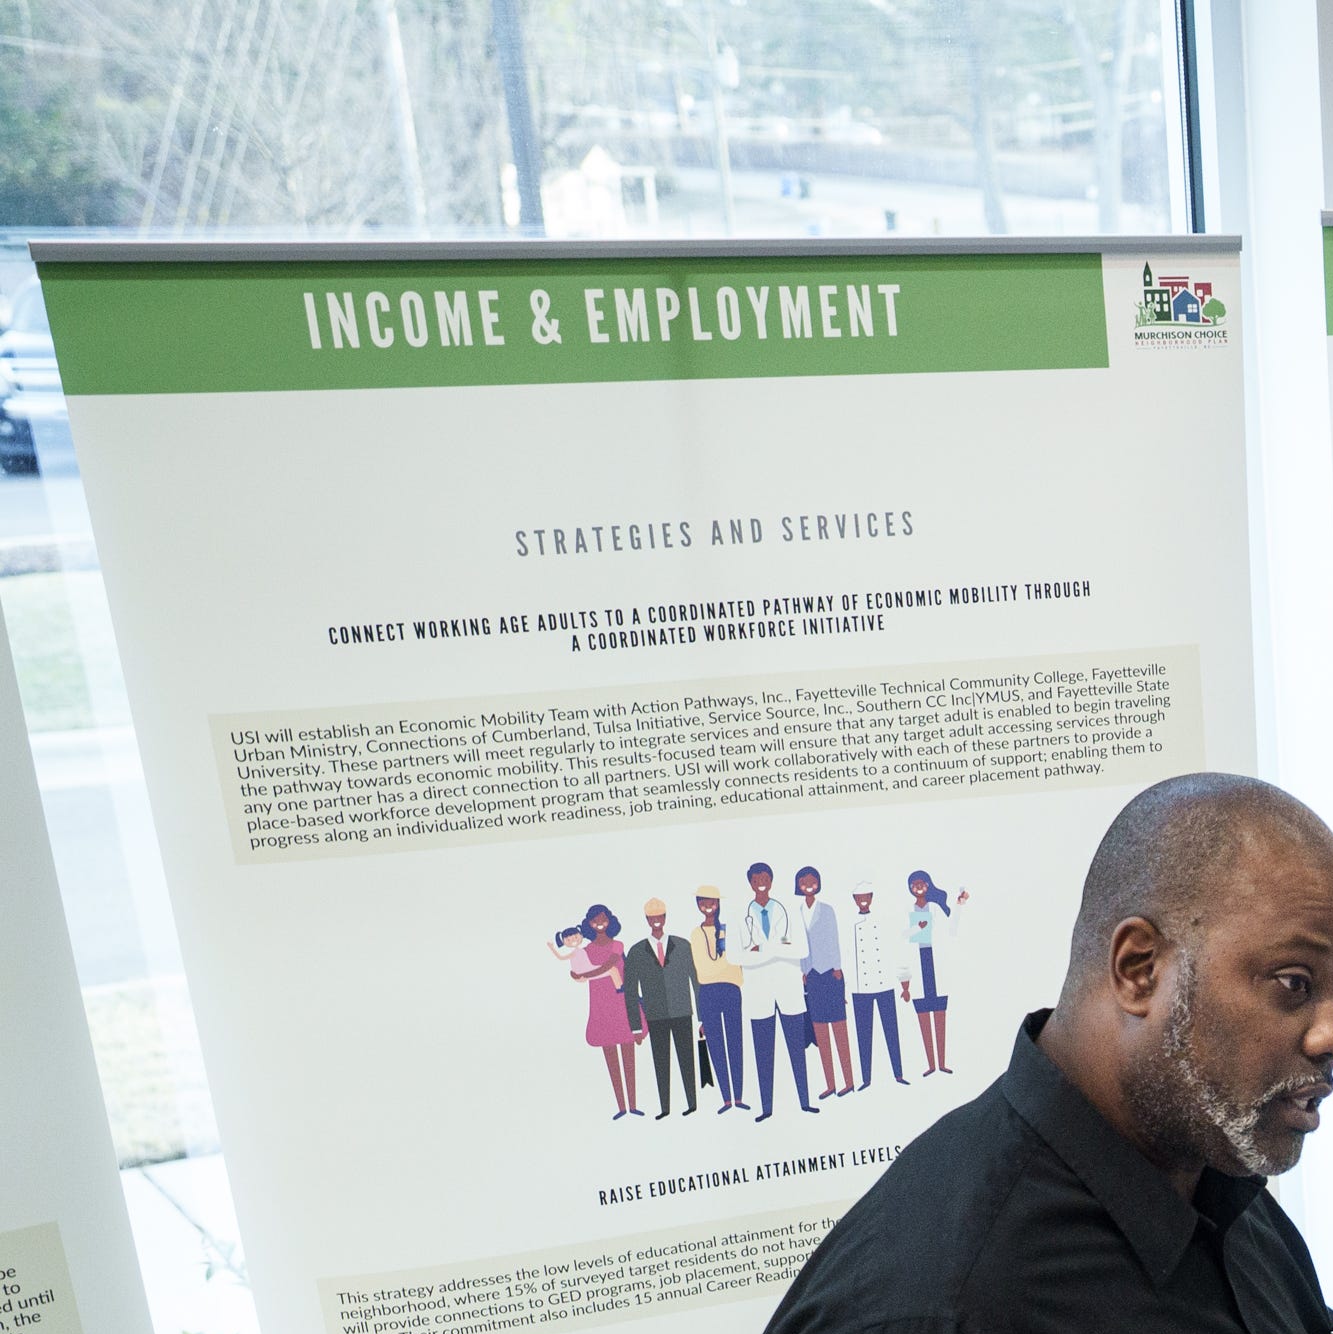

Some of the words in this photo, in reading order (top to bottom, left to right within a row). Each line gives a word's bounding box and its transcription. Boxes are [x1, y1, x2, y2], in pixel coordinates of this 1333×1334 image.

[303, 289, 505, 349] INCOME
[529, 288, 562, 345] &
[583, 283, 900, 343] EMPLOYMENT
[1134, 331, 1192, 340] MURCHISON
[1193, 330, 1227, 339] CHOICE
[515, 521, 692, 557] STRATEGIES
[711, 518, 762, 546] AND
[781, 510, 913, 542] SERVICES
[328, 622, 404, 645] CONNECT
[412, 617, 491, 639] WORKING
[499, 615, 529, 634] AGE
[538, 610, 598, 631] ADULTS
[604, 608, 624, 626] TO
[632, 607, 641, 625] A
[648, 600, 755, 623] COORDINATED
[762, 595, 833, 616] PATHWAY
[841, 593, 858, 611] OF
[866, 589, 942, 609] ECONOMIC
[949, 584, 1017, 604] MOBILITY
[1024, 580, 1090, 600] THROUGH
[572, 634, 581, 652] A
[587, 626, 696, 651] COORDINATED
[703, 619, 795, 641] WORKFORCE
[802, 614, 884, 635] INITIATIVE
[598, 1184, 642, 1206] RAISE
[649, 1167, 749, 1197] EDUCATIONAL
[756, 1152, 845, 1181] ATTAINMENT
[852, 1145, 901, 1166] LEVELS
